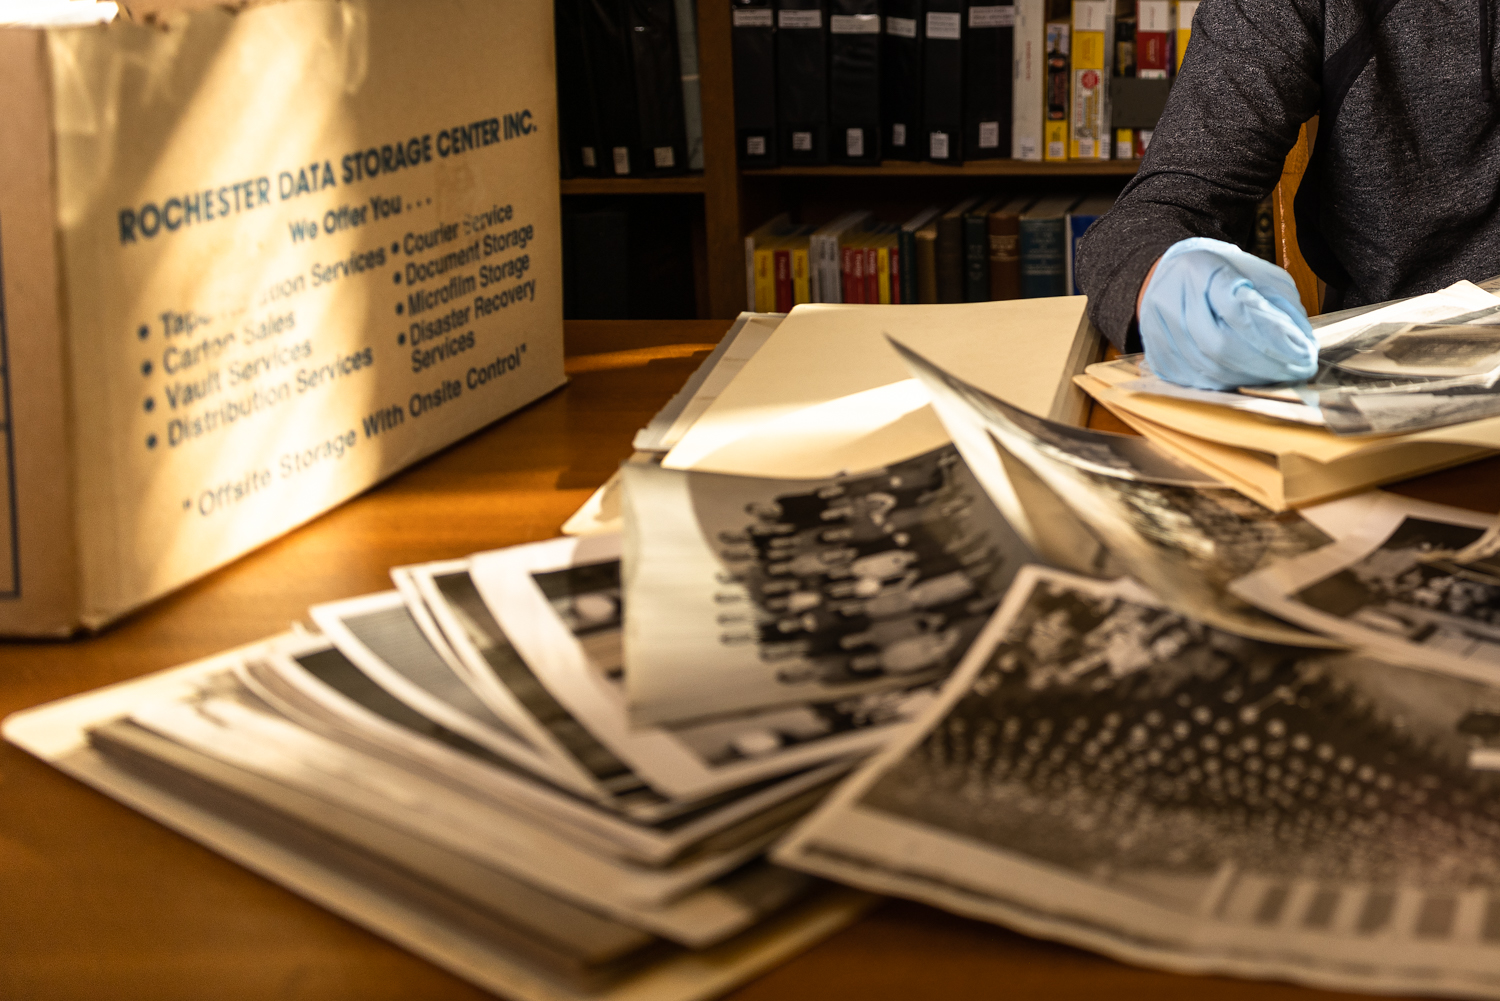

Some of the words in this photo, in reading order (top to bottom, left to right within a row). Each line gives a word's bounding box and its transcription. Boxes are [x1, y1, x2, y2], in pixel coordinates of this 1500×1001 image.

[118, 176, 271, 246] ROCHESTER
[279, 160, 337, 201] DATA
[341, 133, 432, 185] STORAGE
[435, 117, 500, 159] CENTER
[502, 108, 538, 140] INC.
[288, 219, 319, 245] We
[322, 200, 369, 236] Offer
[369, 195, 403, 220] You
[403, 221, 460, 257] Courier
[405, 243, 481, 287] Document
[482, 222, 534, 257] Storage
[407, 273, 476, 317] Microfilm
[478, 253, 531, 289] Storage
[158, 309, 214, 340] Tap
[310, 244, 388, 287] Services
[409, 304, 471, 347] Disaster
[473, 278, 536, 321] Recovery
[243, 309, 297, 347] Sales
[411, 330, 476, 374] Services
[165, 366, 223, 412] Vault
[229, 338, 313, 386] Services
[166, 379, 291, 450] Distribution
[295, 347, 374, 394] Services
[280, 425, 358, 480] Storage
[362, 404, 406, 440] With
[408, 379, 463, 419] Onsite
[465, 342, 528, 391] Control"
